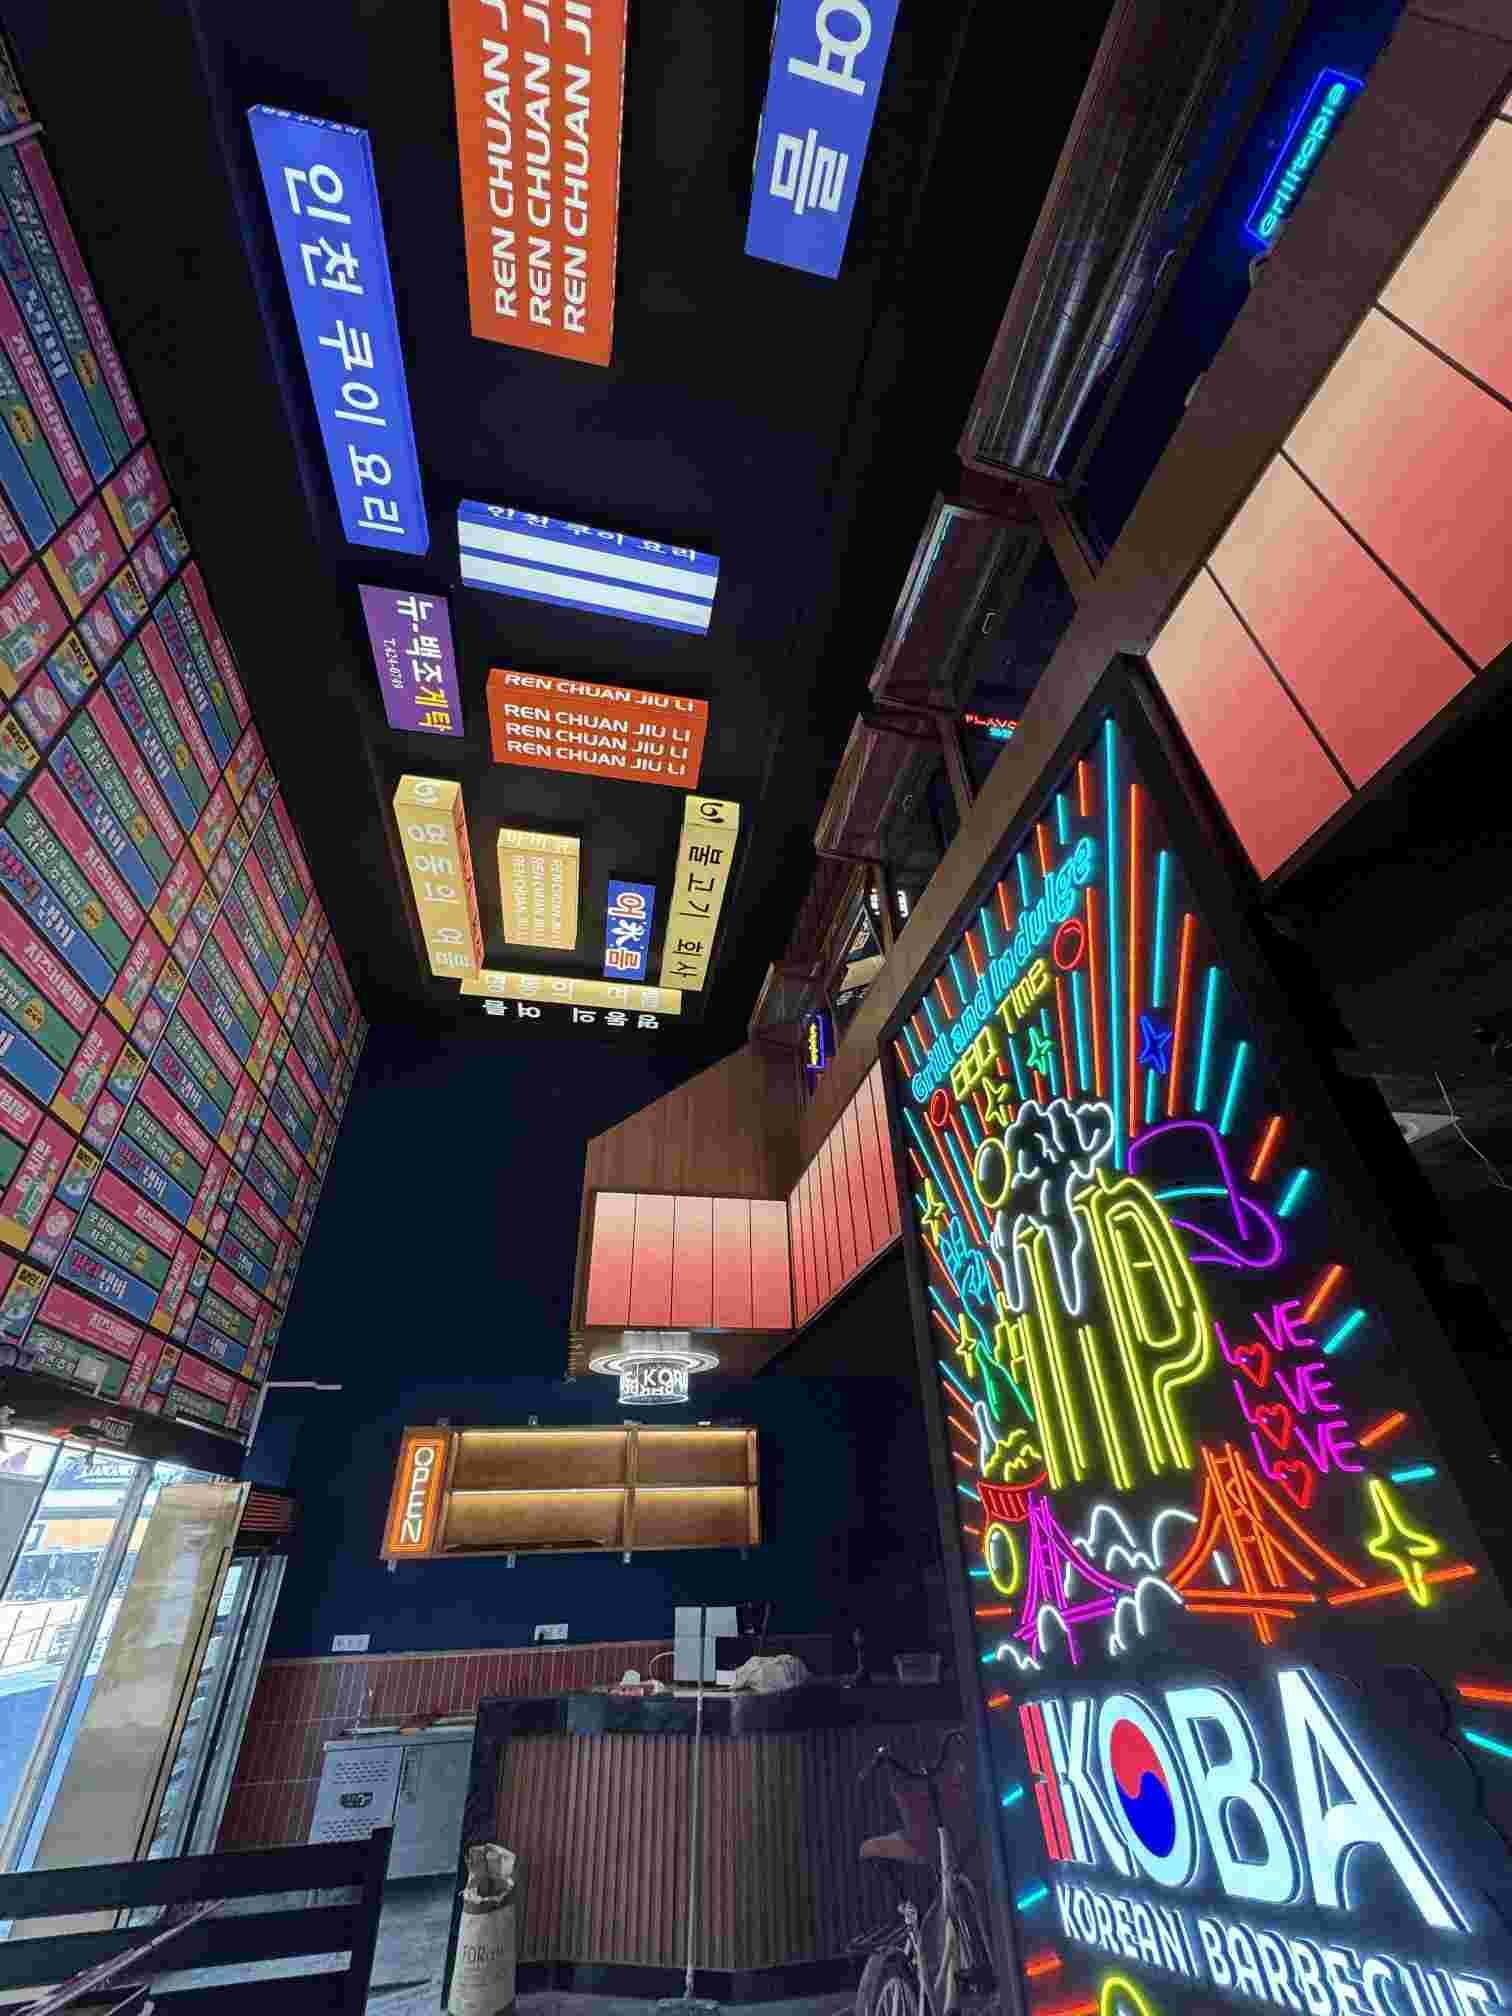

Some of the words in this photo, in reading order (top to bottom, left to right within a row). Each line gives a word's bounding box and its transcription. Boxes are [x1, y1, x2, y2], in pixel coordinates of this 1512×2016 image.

[482, 38, 514, 218] CHUAN
[523, 52, 551, 227] CHUAN
[563, 64, 591, 237] CHUAN
[491, 227, 518, 318] REN
[528, 236, 552, 328] REN
[563, 245, 588, 334] REN
[284, 163, 364, 296] 인천
[349, 444, 405, 536] 요리
[504, 674, 552, 690] REN
[556, 681, 631, 702] CHUAN
[635, 694, 669, 709] JIU
[675, 698, 695, 713] LI
[504, 703, 551, 721] REN
[555, 711, 628, 733] CHUAN
[632, 722, 666, 740] JIU
[672, 726, 691, 742] LI
[505, 722, 551, 740] REN
[556, 730, 627, 751] CHUAN
[631, 740, 665, 756] JIU
[670, 745, 688, 760] LI
[507, 740, 551, 757] REN
[556, 746, 626, 767] CHUAN
[630, 757, 662, 773] JIU
[668, 761, 686, 776] LI
[679, 844, 725, 918] 불고기
[400, 1446, 435, 1544] OPEN
[1038, 1667, 1473, 1933] KOBA
[1055, 1882, 1198, 1978] KOREAN
